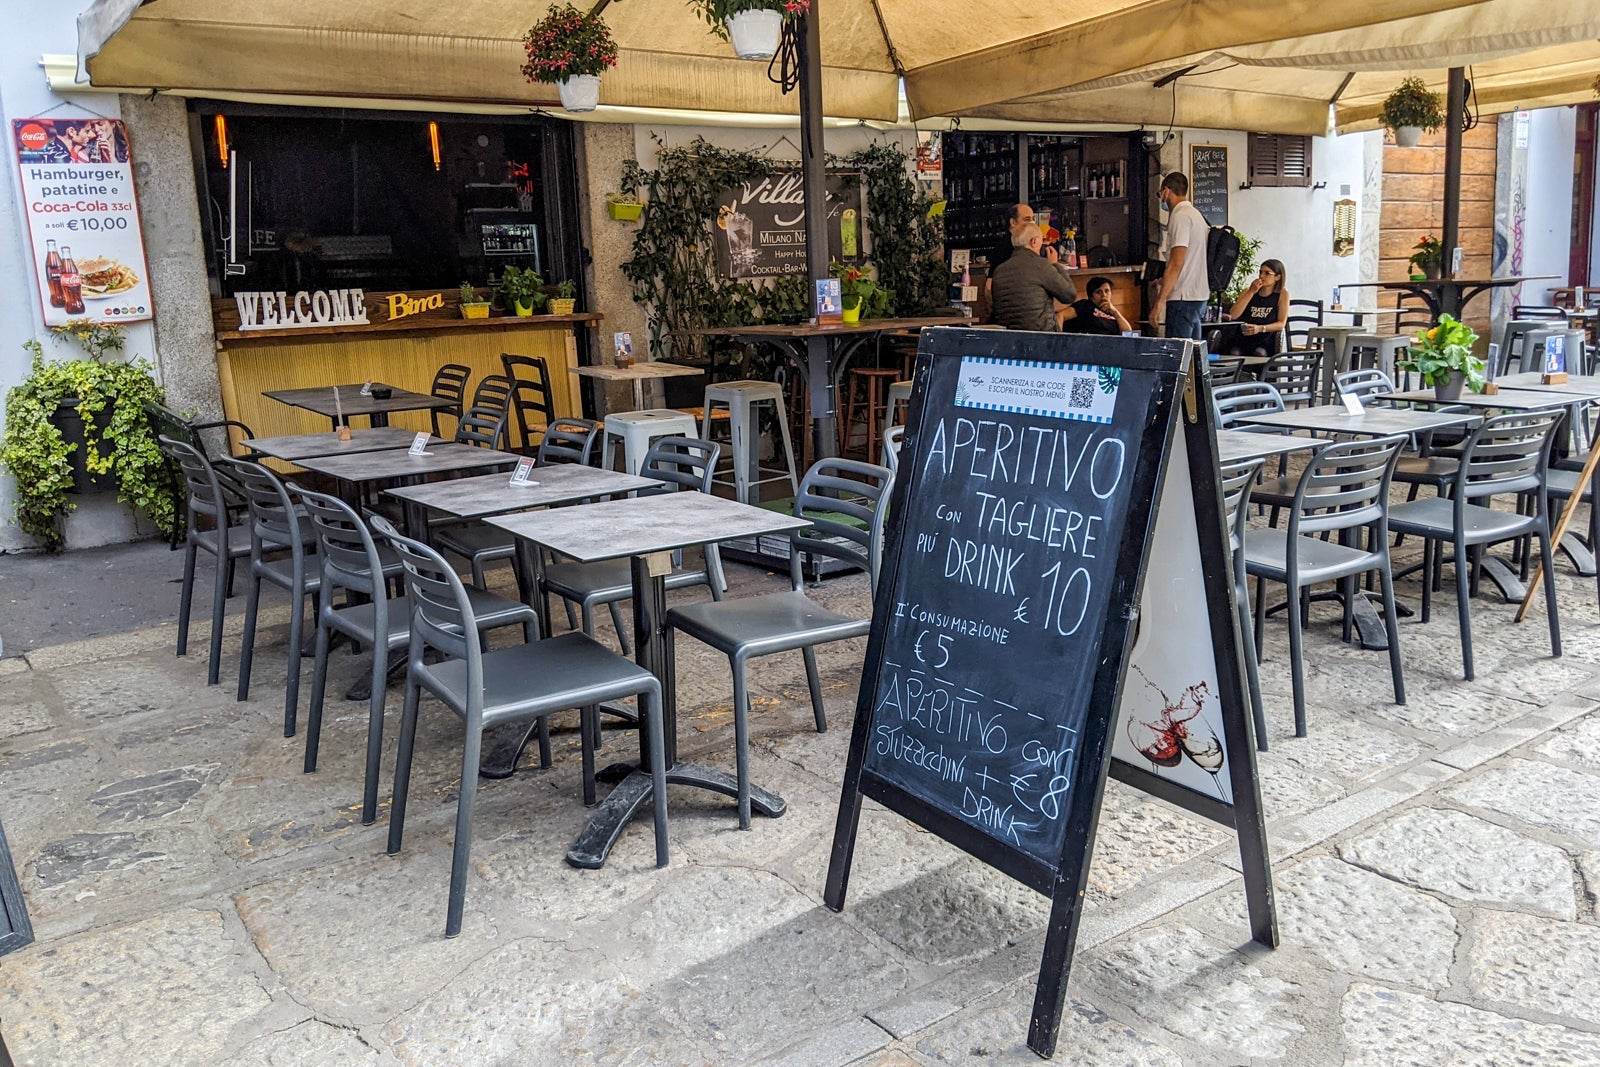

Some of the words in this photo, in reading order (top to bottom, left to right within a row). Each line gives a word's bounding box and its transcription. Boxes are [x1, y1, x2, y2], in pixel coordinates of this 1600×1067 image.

[22, 132, 45, 140] Coca-Cola
[31, 168, 123, 181] Hamburger,
[42, 184, 107, 197] patatine
[32, 200, 108, 213] Coca-Cola
[111, 203, 132, 211] 33cl
[67, 217, 127, 232] €10,00
[234, 288, 368, 328] WELCOME
[991, 376, 1029, 387] SCANNERIZZA
[1030, 380, 1035, 388] IL
[1036, 380, 1046, 388] QR
[1046, 381, 1066, 390] CODE
[993, 385, 1014, 394] SCOPRI
[1020, 388, 1045, 397] NOSTRO
[923, 417, 1125, 499] APERITIVO
[976, 492, 1102, 558] TAGLIERE
[944, 537, 1025, 596] DRINK
[1013, 597, 1031, 624] €
[1041, 561, 1092, 636] 10
[876, 673, 1008, 754] APERITIVO
[960, 787, 1028, 847] DRINK
